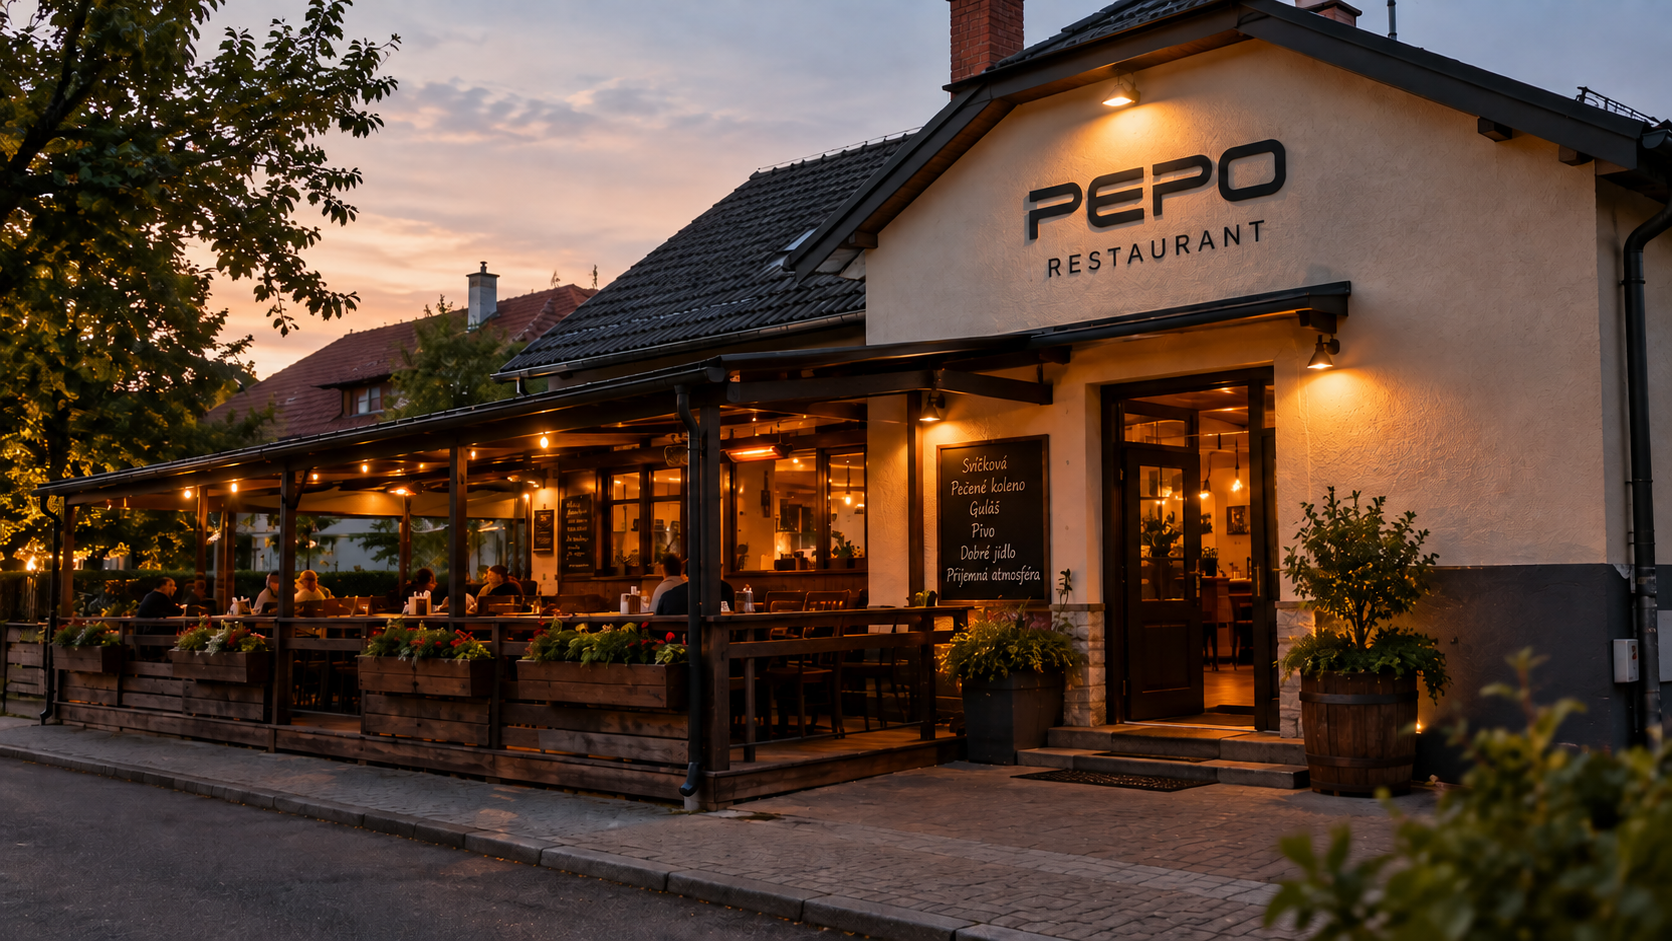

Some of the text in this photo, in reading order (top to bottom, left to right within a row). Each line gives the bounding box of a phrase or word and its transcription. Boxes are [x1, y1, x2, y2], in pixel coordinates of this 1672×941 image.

[1029, 139, 1286, 241] PEPO
[1048, 220, 1265, 278] RESTAURANT
[962, 455, 1007, 474] Svíčková
[951, 476, 1026, 496] Pečené koleno
[971, 522, 995, 538] Pivo
[961, 545, 990, 560] Dobré
[991, 564, 1041, 585] atmosféra
